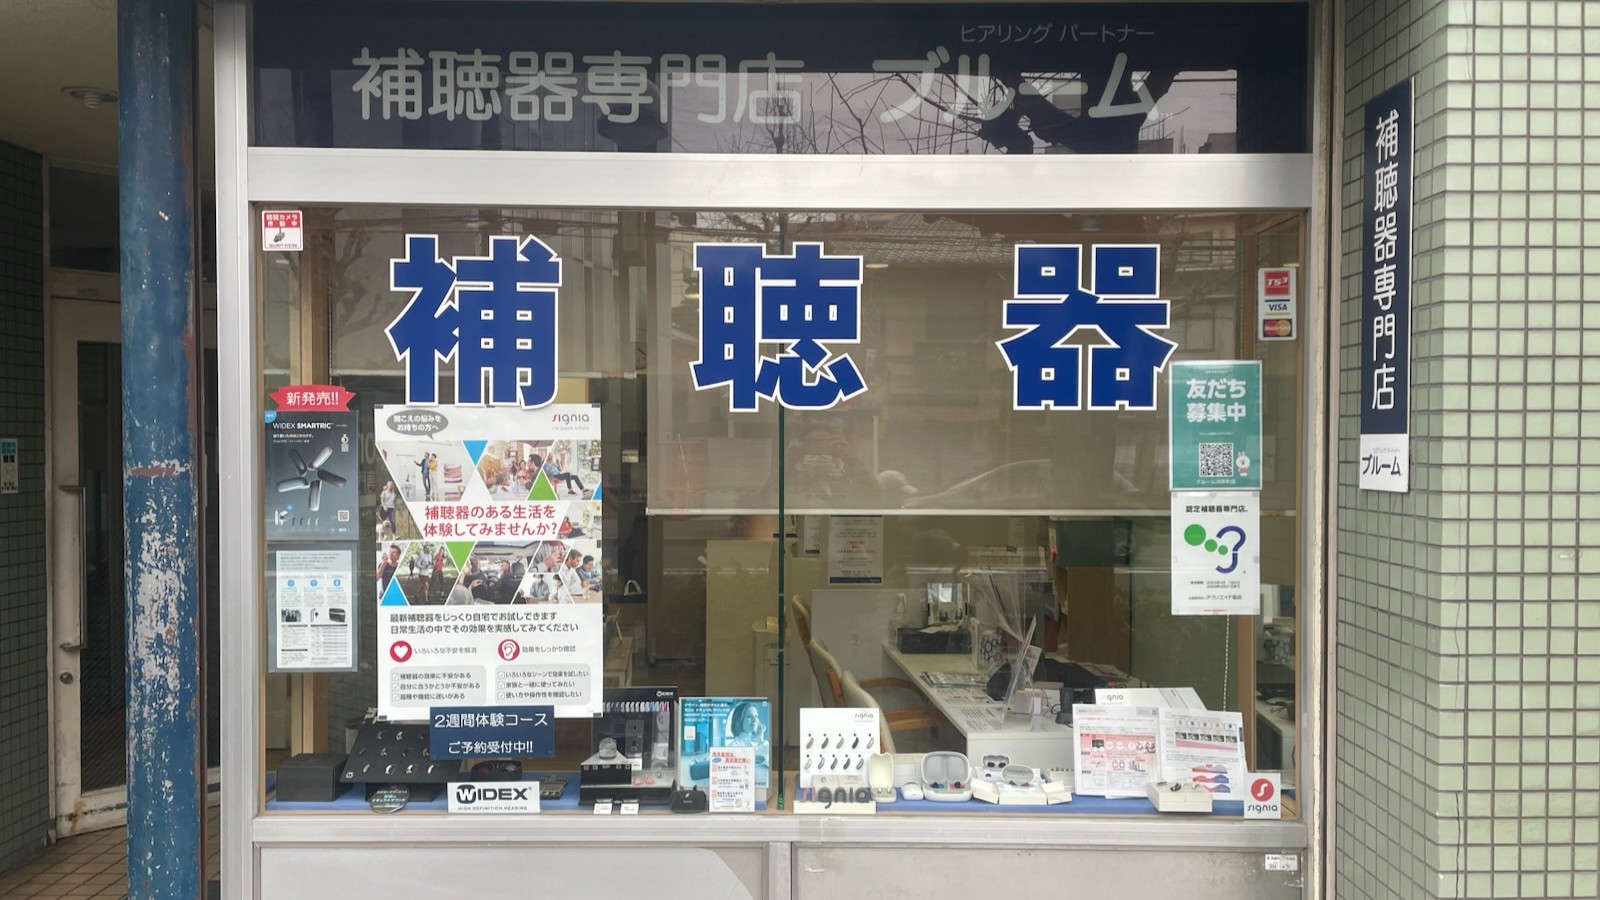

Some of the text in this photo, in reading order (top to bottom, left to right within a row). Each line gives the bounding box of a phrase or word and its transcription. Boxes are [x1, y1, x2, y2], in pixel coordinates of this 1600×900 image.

[961, 23, 1155, 43] ヒアリング パートナー
[351, 46, 1161, 125] 補聴器専門店 ブルーム
[1372, 109, 1400, 411] 補聴器専門店
[385, 234, 1178, 413] 補聴器
[1186, 379, 1247, 399] 友だち
[552, 413, 590, 425] signia
[1186, 402, 1247, 422] 募集中
[396, 424, 440, 432] お持ちの方へ
[1362, 453, 1401, 476] ブルーム
[425, 505, 556, 520] 補聴器のある生活を
[390, 612, 558, 623] 最新補聴器をじっくり自宅でお試しできます
[390, 623, 579, 634] 日常生活の中でその効果を実感してみてください
[434, 713, 548, 729] 2週間体験コース
[456, 784, 528, 805] WIDEX
[1247, 804, 1278, 814] signia
